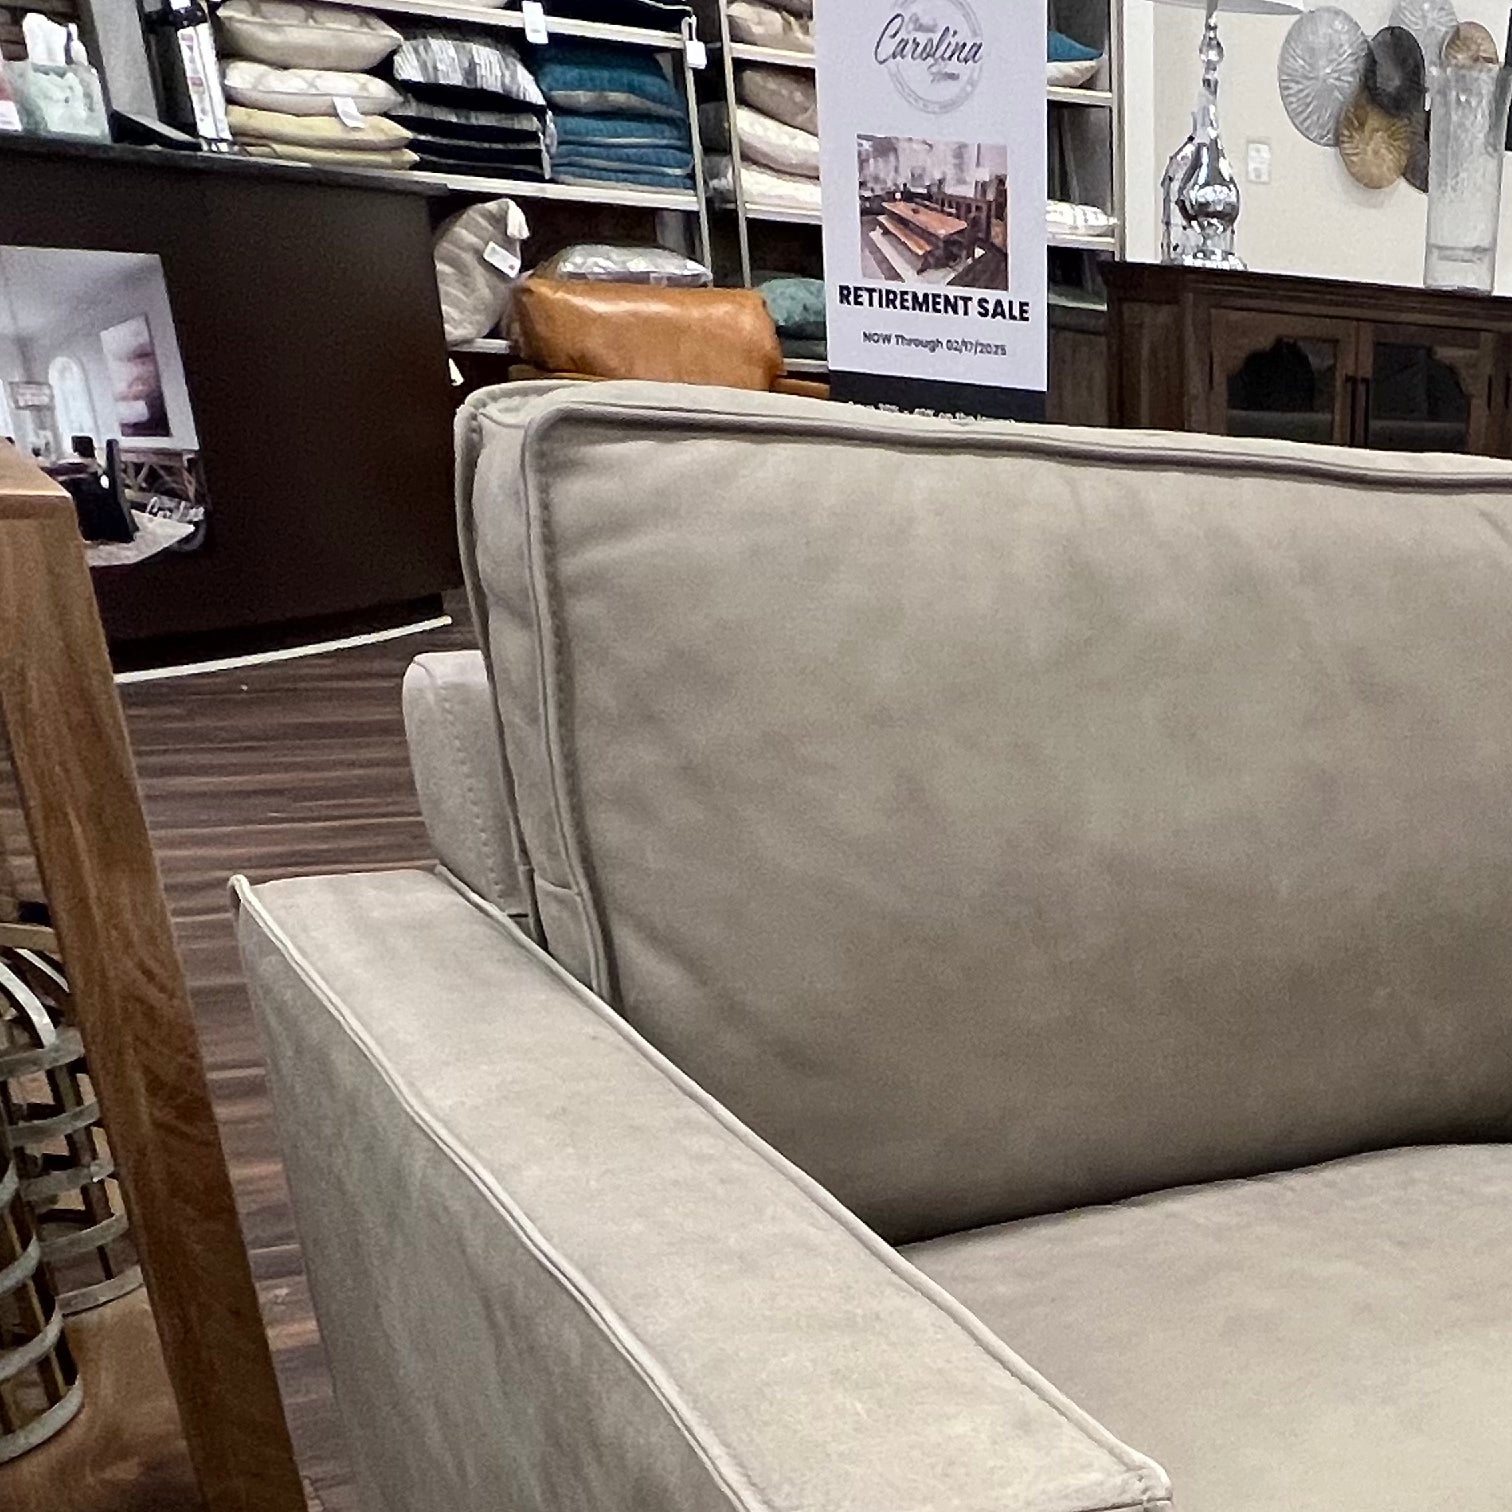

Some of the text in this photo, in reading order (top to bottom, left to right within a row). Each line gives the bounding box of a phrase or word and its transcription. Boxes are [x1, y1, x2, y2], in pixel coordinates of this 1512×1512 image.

[874, 13, 983, 65] Carolina
[838, 285, 1030, 322] RETIREMENT SALE
[862, 331, 892, 345] NOW
[894, 334, 944, 353] Through
